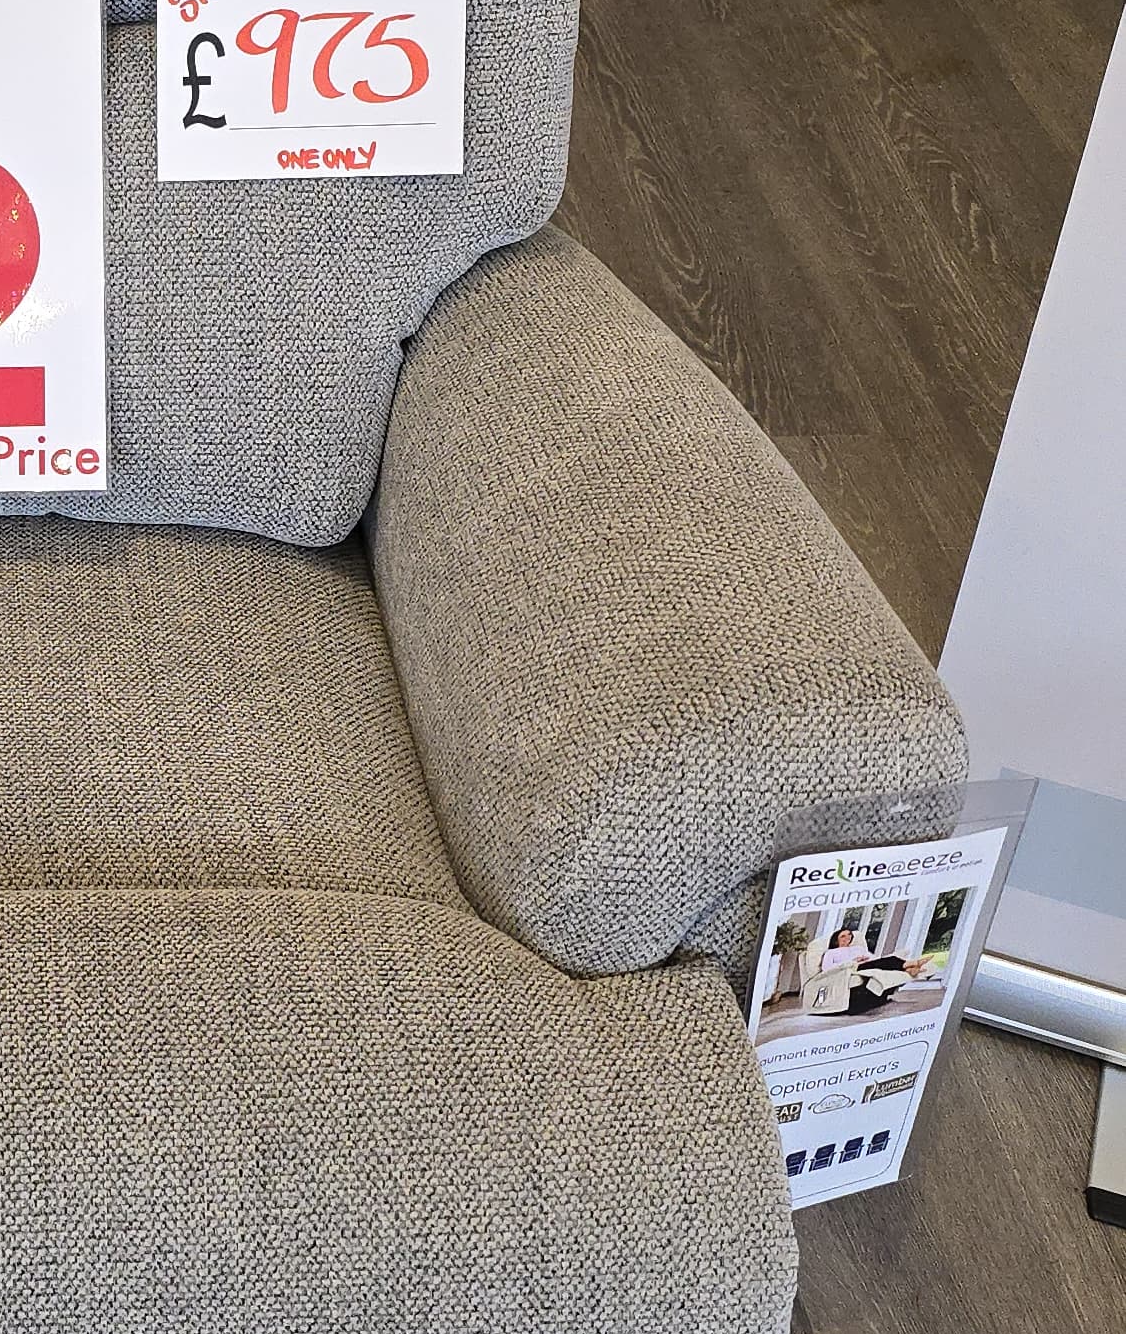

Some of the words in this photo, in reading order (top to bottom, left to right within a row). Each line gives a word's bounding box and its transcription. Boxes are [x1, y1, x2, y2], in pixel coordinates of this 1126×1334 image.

[277, 148, 319, 170] ONE
[322, 141, 377, 171] ONLY
[784, 881, 912, 912] Beaumont
[759, 1049, 808, 1067] aumont
[810, 1041, 851, 1057] Range
[853, 1021, 936, 1051] Specifications
[770, 1072, 844, 1098] Optional
[847, 1060, 900, 1082] Extra's
[774, 1104, 801, 1117] EAD
